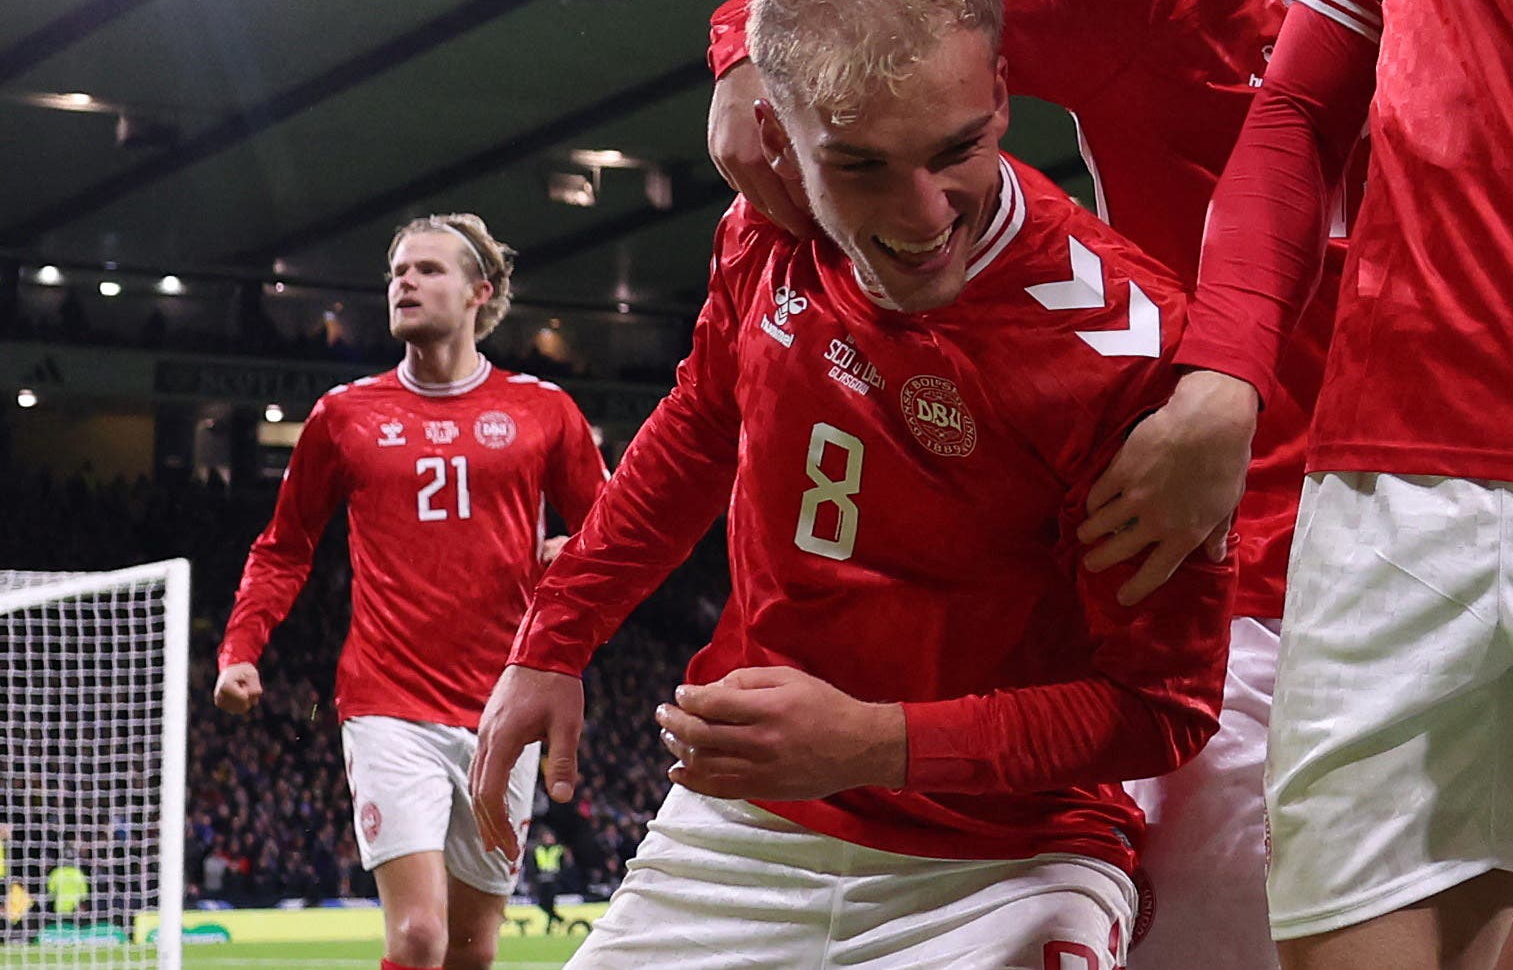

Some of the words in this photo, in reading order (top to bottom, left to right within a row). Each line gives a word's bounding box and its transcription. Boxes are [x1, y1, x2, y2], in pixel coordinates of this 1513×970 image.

[824, 338, 856, 369] SCO
[828, 365, 870, 396] GLASGOW
[917, 398, 962, 432] DBU
[415, 455, 471, 521] 21
[794, 422, 864, 561] 8
